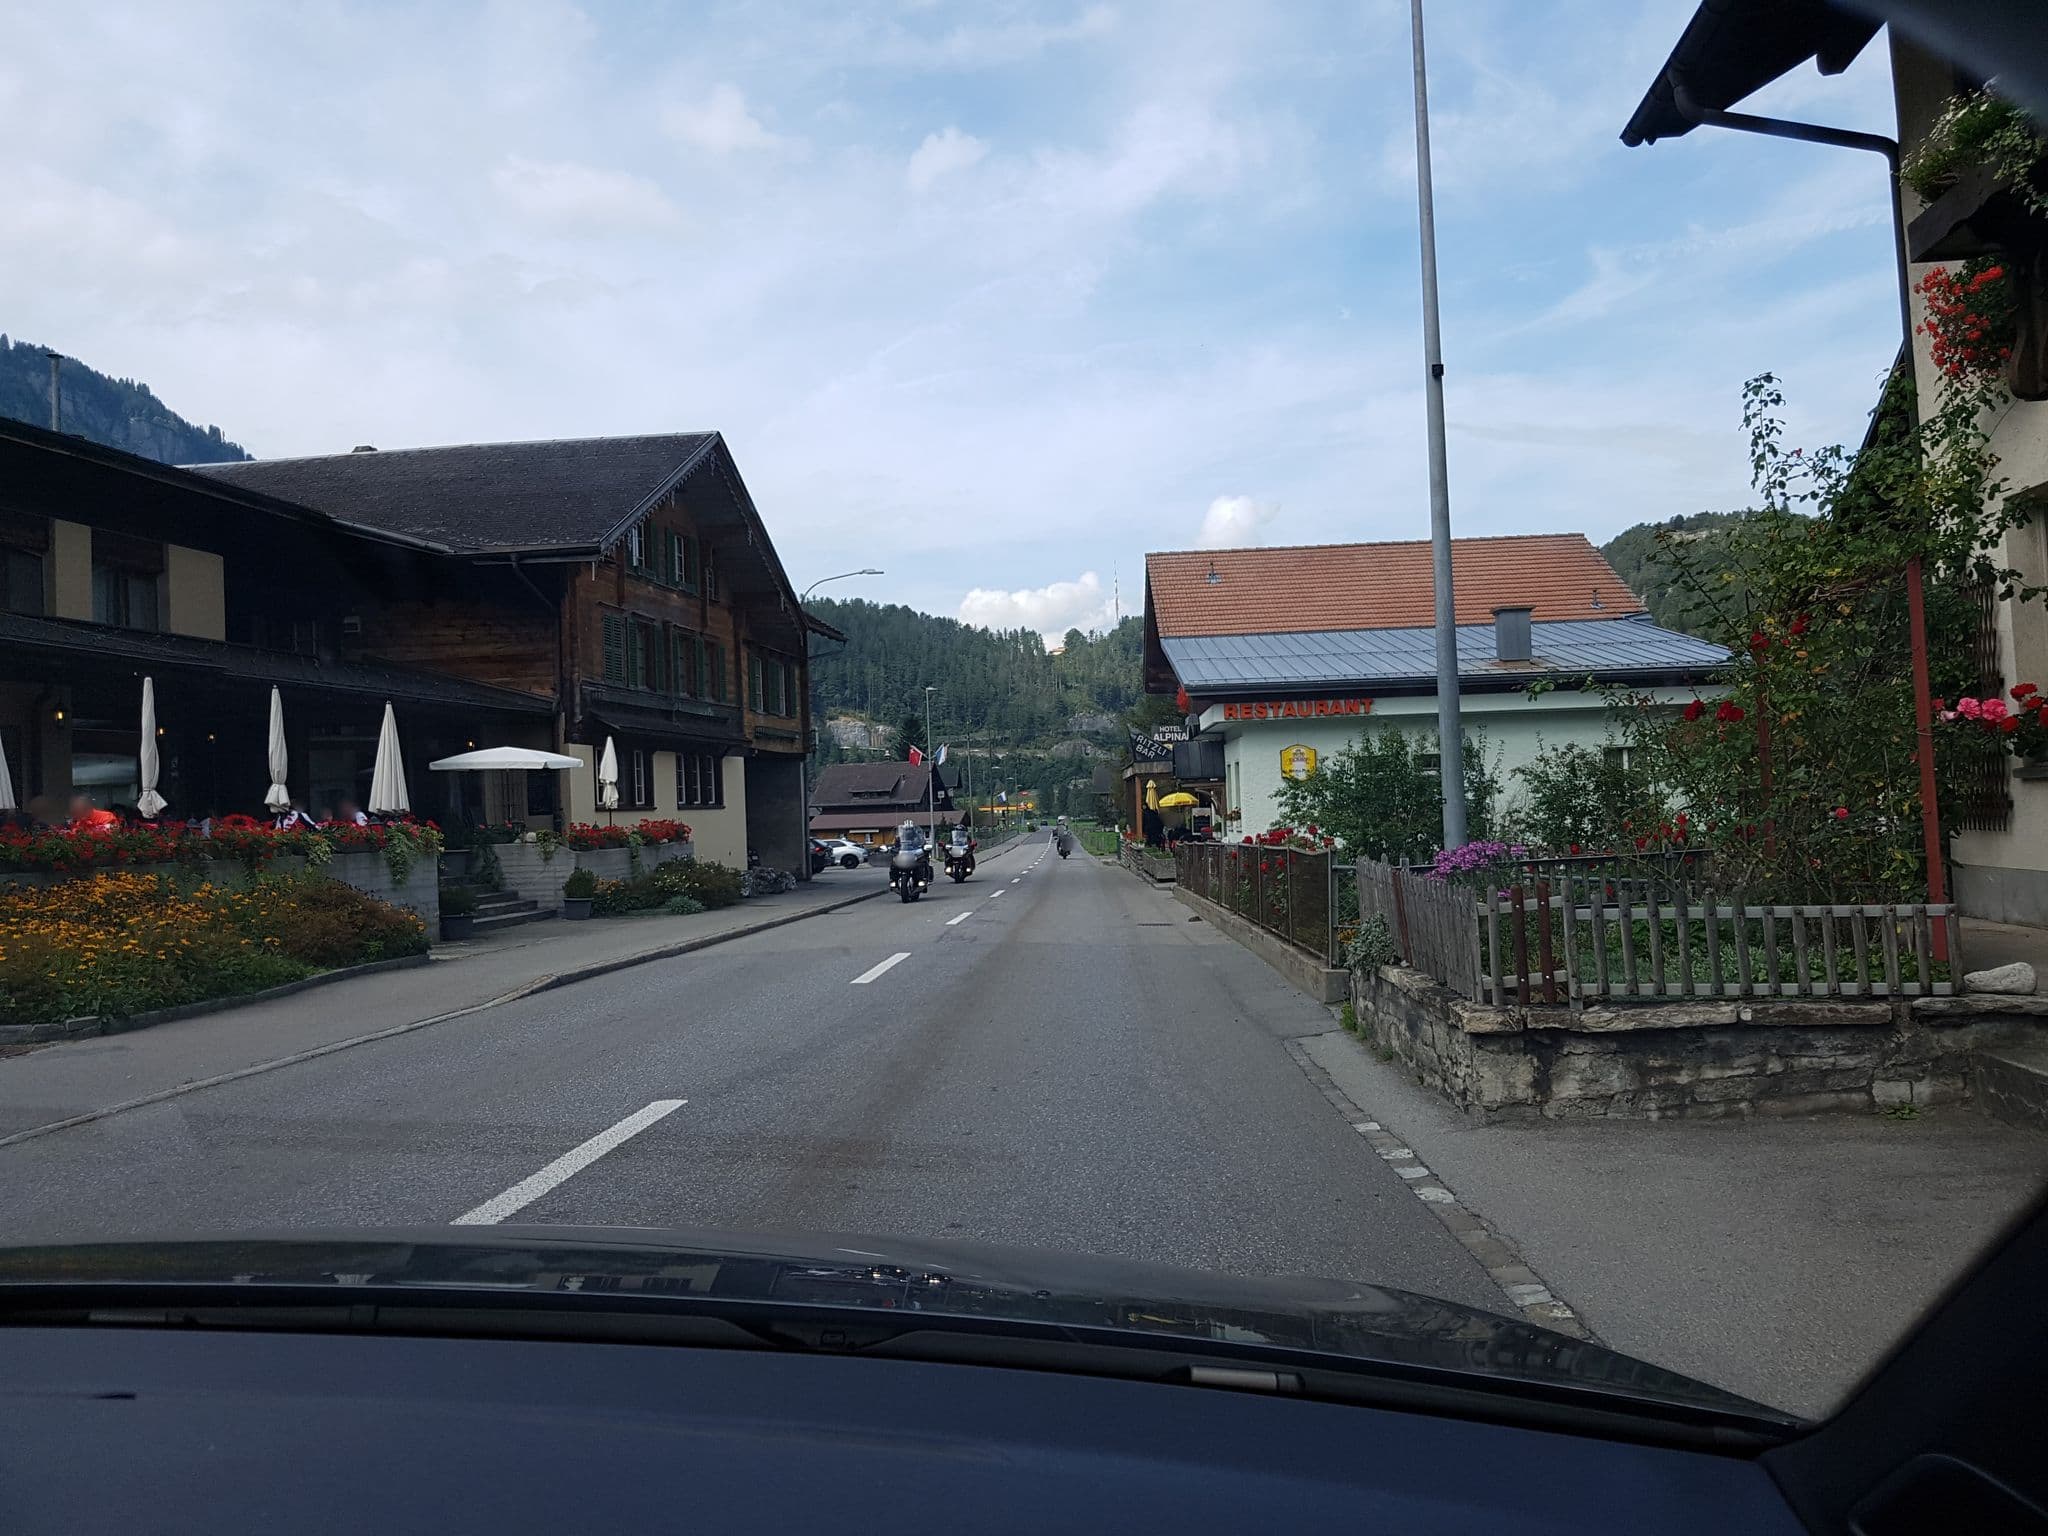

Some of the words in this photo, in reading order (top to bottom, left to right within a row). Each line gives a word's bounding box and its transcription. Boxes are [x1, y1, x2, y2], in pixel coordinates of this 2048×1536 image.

[1223, 698, 1374, 720] RESTAURANT
[1153, 732, 1187, 741] ALPINA
[1159, 725, 1182, 733] HOTEL
[1135, 744, 1155, 759] BAR
[1136, 735, 1167, 756] RITZLI
